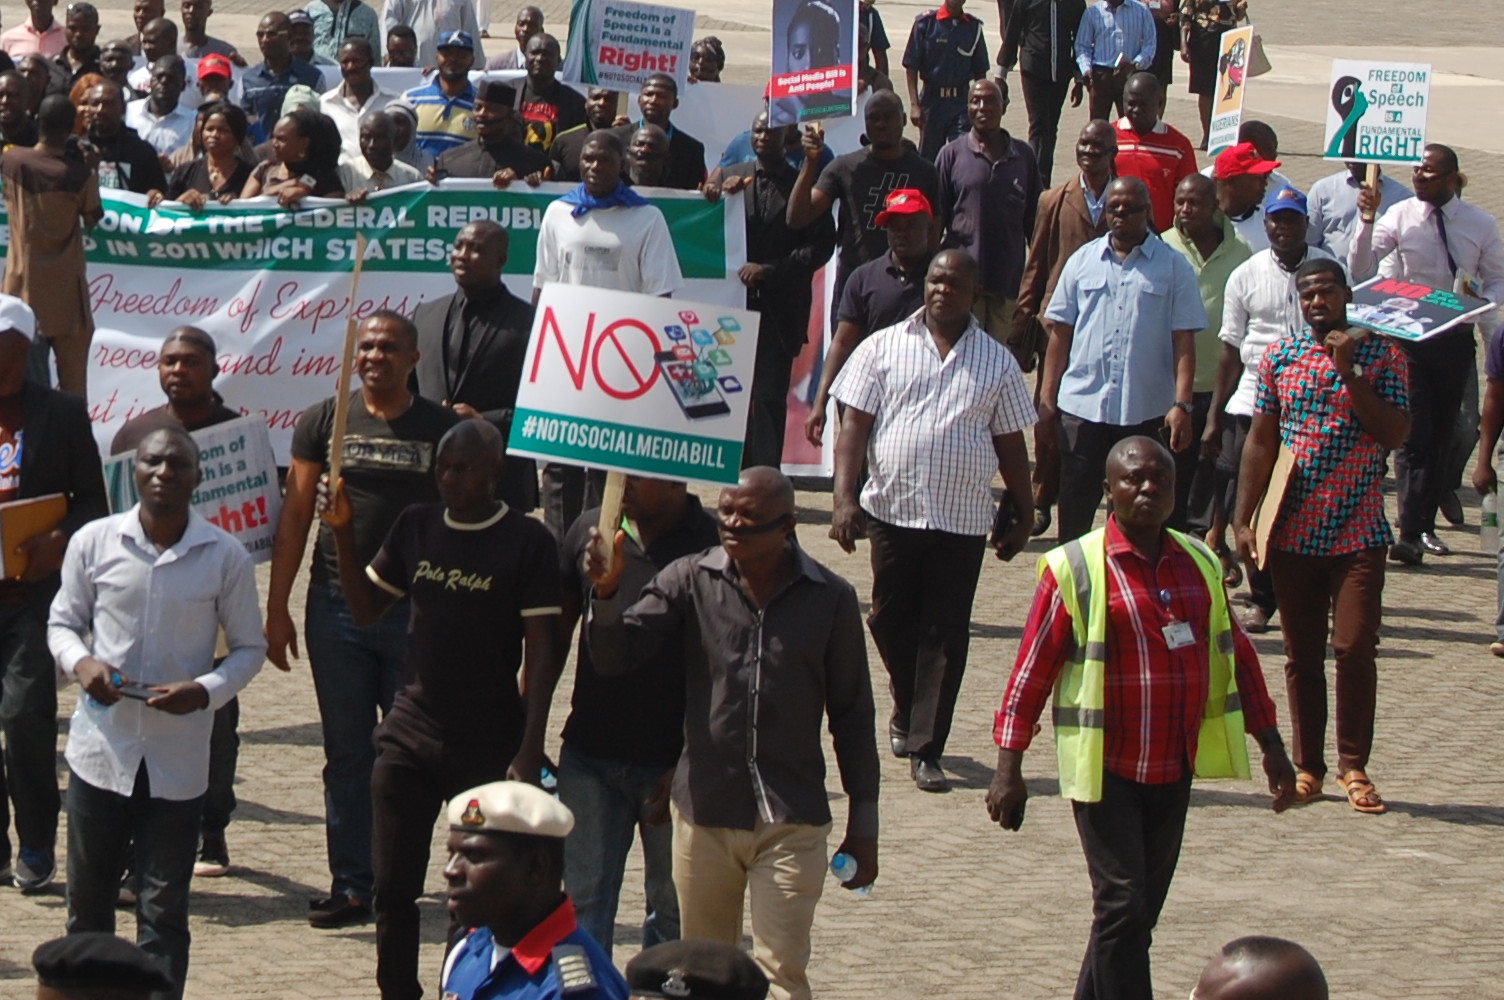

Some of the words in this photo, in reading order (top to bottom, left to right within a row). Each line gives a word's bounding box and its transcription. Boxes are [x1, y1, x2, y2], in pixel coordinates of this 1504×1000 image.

[605, 6, 659, 22] Freedom
[663, 15, 676, 24] of
[603, 19, 647, 33] Speech
[651, 26, 660, 34] is
[664, 28, 671, 36] a
[602, 31, 683, 50] Fundamental
[599, 46, 678, 73] Right!
[777, 75, 800, 86] Social
[801, 72, 824, 82] Media
[825, 70, 838, 78] Bill
[1368, 69, 1426, 83] FREEDOM
[1368, 89, 1424, 109] Speech
[1360, 126, 1421, 136] FUNDAMENTAL
[1359, 135, 1421, 157] RIGHT
[208, 215, 264, 234] THE
[275, 206, 415, 231] FEDERAL
[105, 241, 139, 257] IN
[149, 242, 211, 259] 2011
[213, 238, 313, 260] WHICH
[1370, 279, 1433, 298] NO
[87, 273, 219, 316] Freedom
[228, 279, 261, 334] of
[216, 336, 282, 376] and
[529, 305, 662, 401] NO
[229, 435, 246, 453] of
[522, 415, 725, 469] #NOTOSOCIALMEDIABILL
[220, 462, 233, 476] is
[236, 459, 247, 471] a
[191, 471, 269, 505] damental
[413, 560, 444, 583] Polo
[445, 569, 493, 591] Ralph
